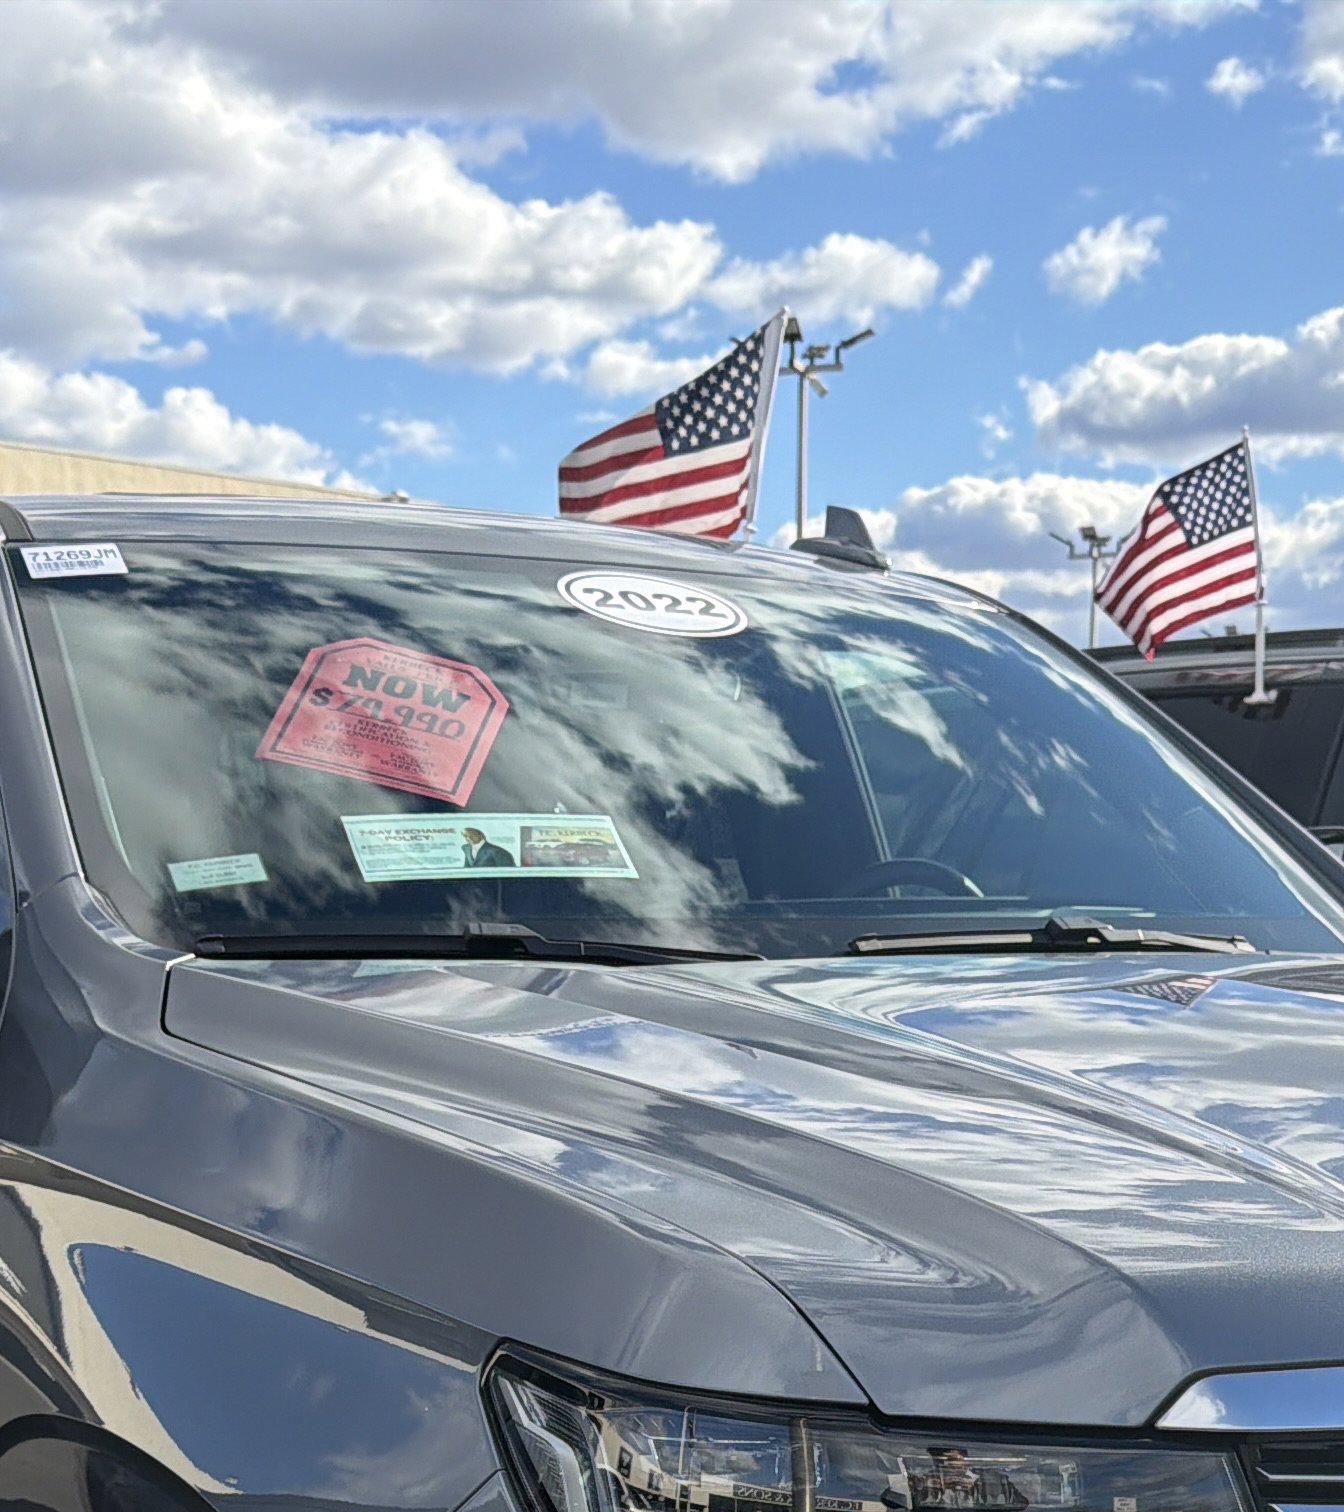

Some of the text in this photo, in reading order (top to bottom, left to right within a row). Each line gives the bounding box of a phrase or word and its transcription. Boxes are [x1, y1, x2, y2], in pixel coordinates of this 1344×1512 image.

[28, 548, 118, 562] 71269JM
[582, 587, 729, 619] 2022
[342, 663, 472, 714] NOW
